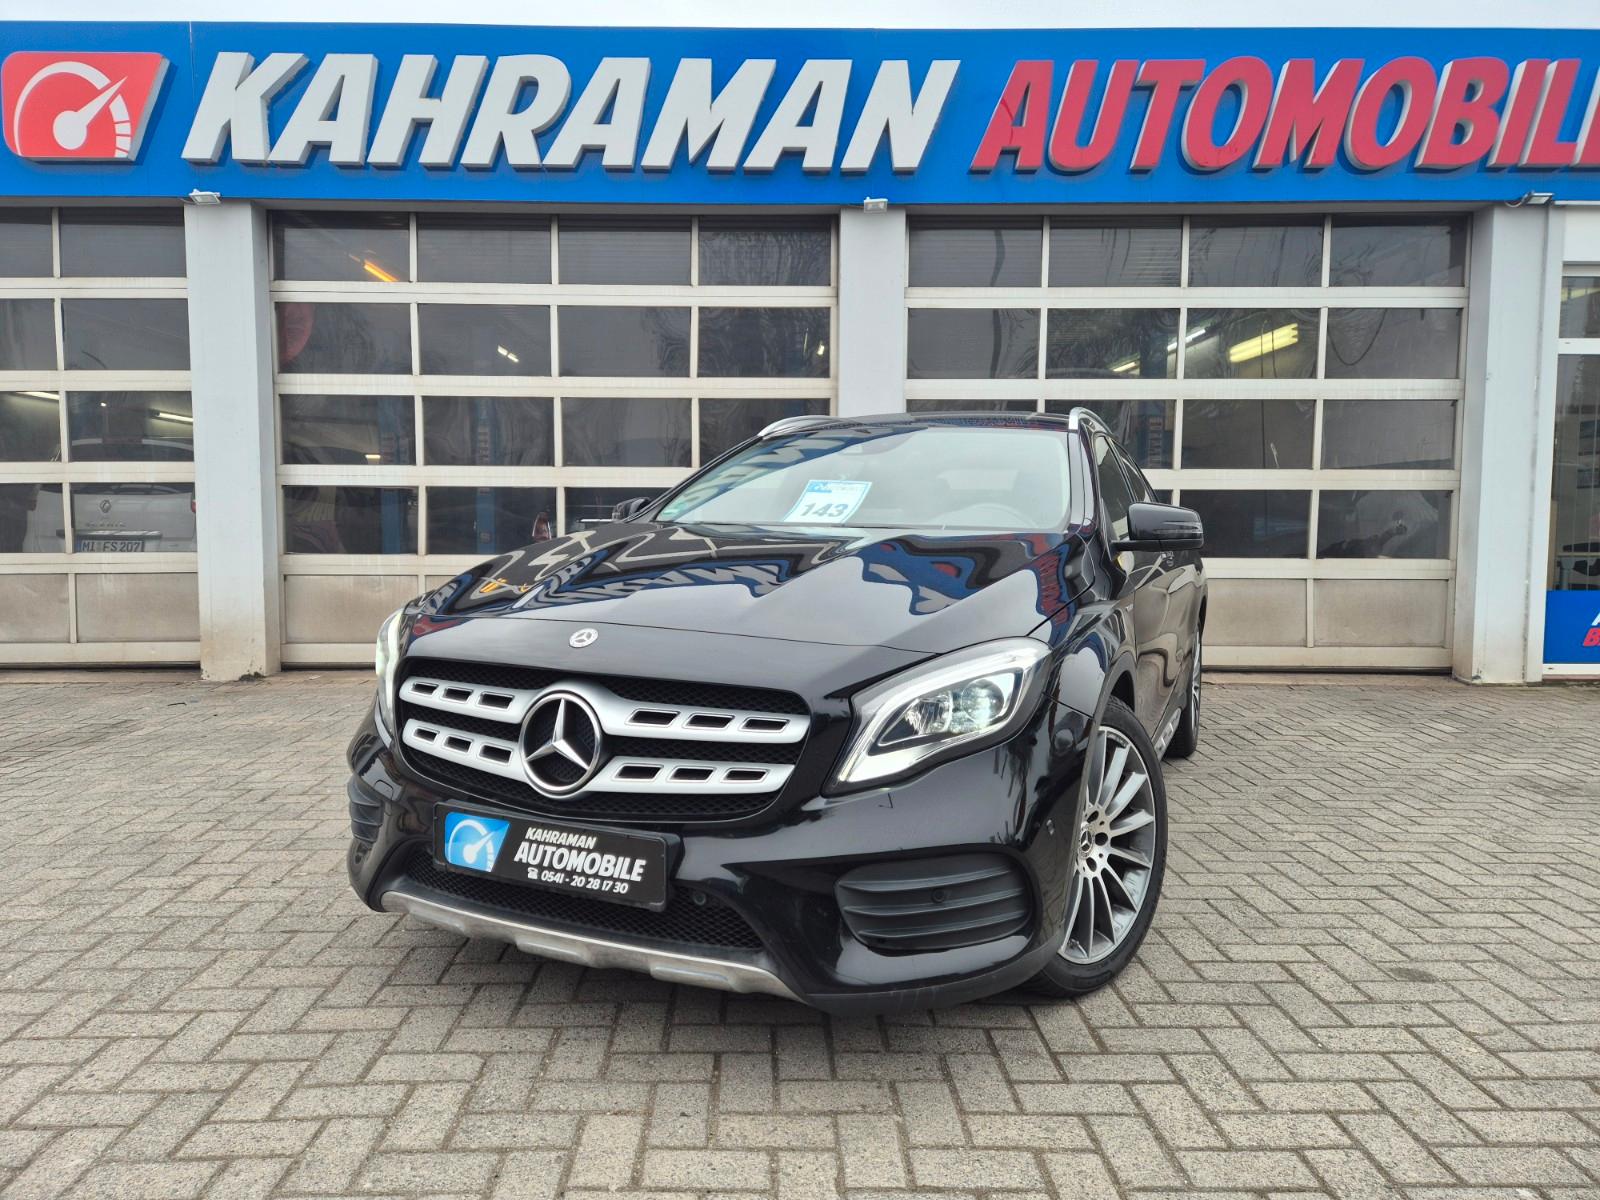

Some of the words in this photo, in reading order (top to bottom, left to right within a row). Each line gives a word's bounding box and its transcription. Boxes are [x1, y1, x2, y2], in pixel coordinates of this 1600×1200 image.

[181, 52, 961, 172] KAHRAMAN
[800, 503, 848, 517] 143
[82, 541, 96, 552] MI
[525, 827, 597, 849] KAHRAMAN
[514, 841, 646, 881] AUTOMOBILE
[541, 870, 565, 885] 0541
[570, 875, 588, 888] 20
[586, 877, 602, 890] 28
[601, 880, 613, 892] 17
[613, 882, 629, 893] 30
